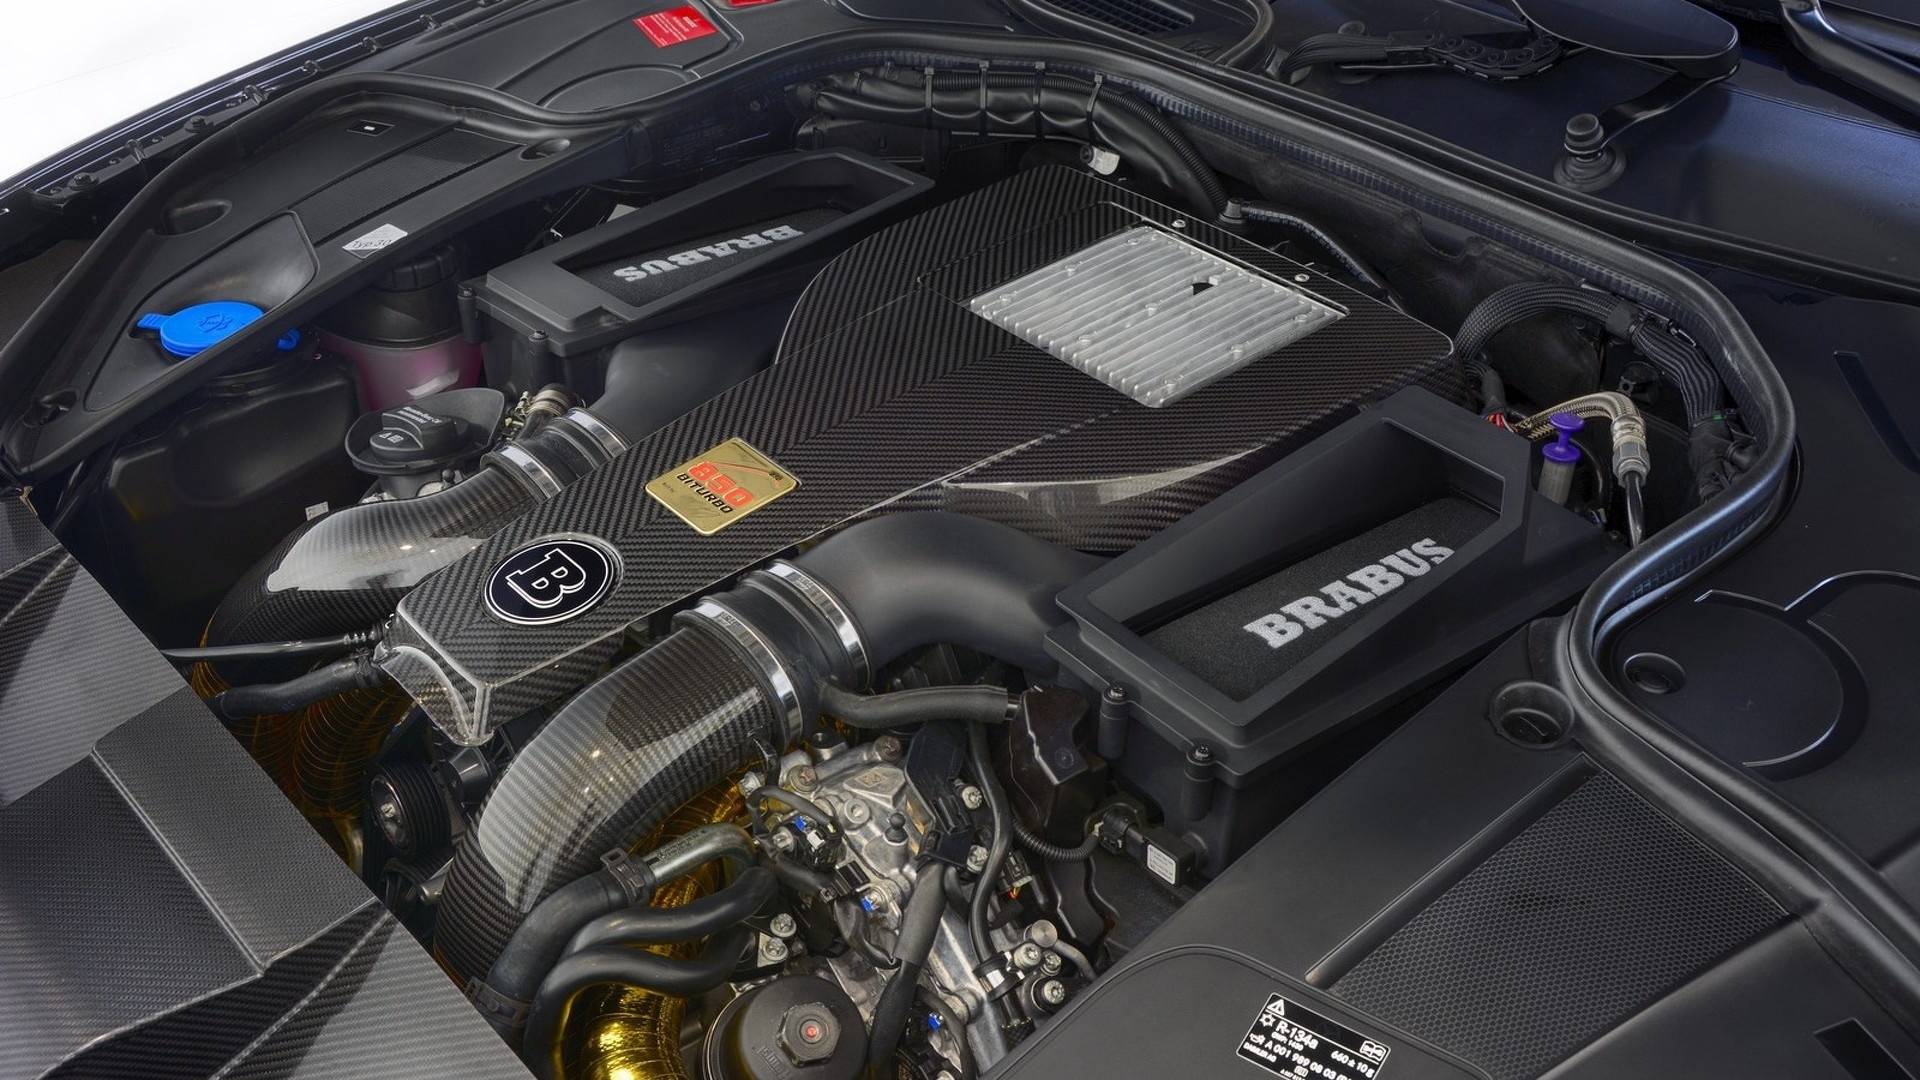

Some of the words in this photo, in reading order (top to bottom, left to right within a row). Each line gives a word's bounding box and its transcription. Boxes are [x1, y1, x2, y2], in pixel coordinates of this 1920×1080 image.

[613, 224, 805, 282] BRABUS
[676, 472, 734, 514] BITURBO
[687, 461, 755, 508] 850
[505, 547, 587, 609] B
[1242, 537, 1456, 649] BRABUS
[1264, 1040, 1273, 1050] A
[1273, 1044, 1292, 1058] 001
[1291, 1053, 1311, 1067] 989
[1275, 1020, 1319, 1050] R-134a
[1331, 1050, 1349, 1064] 660
[1356, 1062, 1369, 1073] 10
